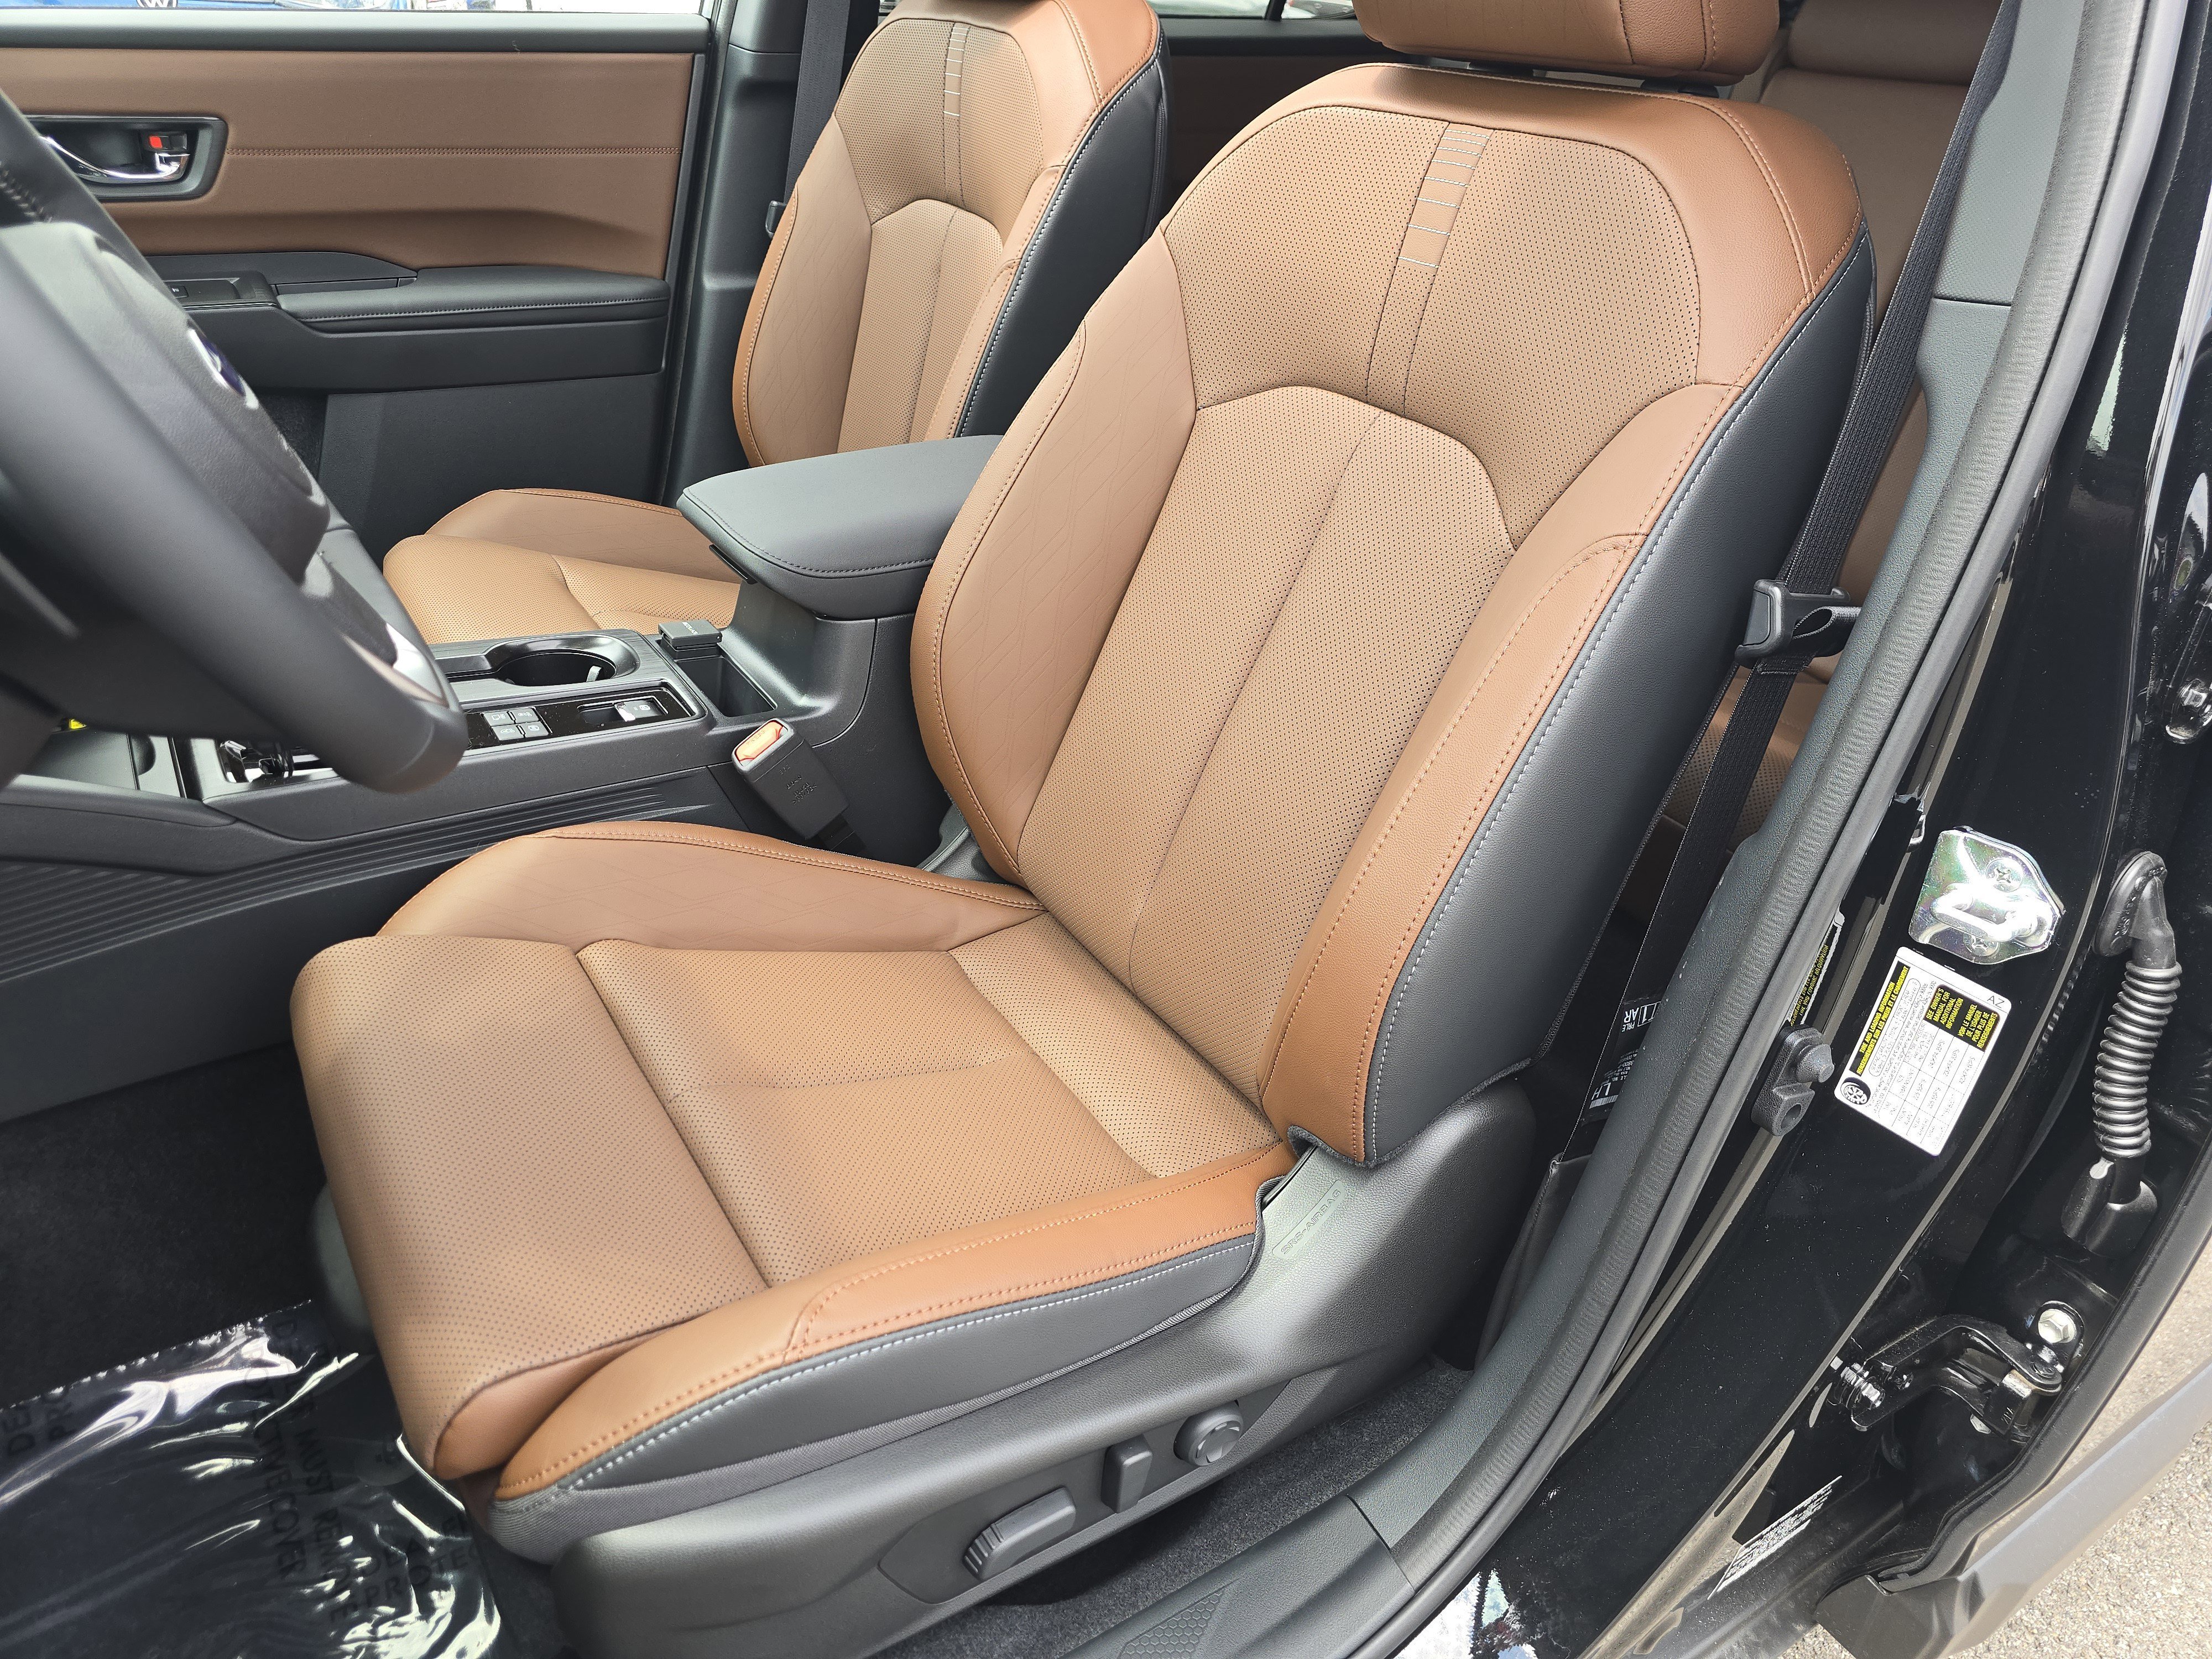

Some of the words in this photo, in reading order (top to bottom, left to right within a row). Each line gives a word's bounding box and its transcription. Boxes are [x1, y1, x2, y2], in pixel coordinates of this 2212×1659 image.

[1624, 1007, 1640, 1023] AR
[1926, 1010, 1934, 1020] SEE
[1931, 988, 1944, 1010] OWNER'S
[1933, 1003, 1945, 1021] MANUAL
[1942, 992, 1950, 1001] FOR
[1940, 998, 1956, 1025] ADDITIONAL
[1945, 998, 1963, 1029] INFORMATION
[1987, 994, 2005, 1009] AZ
[1857, 1039, 1876, 1074] RENSEIGNEMENTS
[1881, 1006, 1891, 1021] PNEUS
[1893, 966, 1909, 994] CHARGEMENT
[1859, 1042, 1869, 1053] TIRE
[1869, 1013, 1881, 1033] LOADING
[1879, 982, 1895, 1013] INFORMATION
[1958, 1026, 1966, 1036] VOIR
[1965, 1004, 1977, 1021] MANUEL
[1969, 1010, 1982, 1031] L'USAGER
[1971, 1030, 1981, 1042] POUR
[1977, 1019, 1986, 1030] PLUS
[1977, 1013, 1997, 1048] RENSEIGNEMENTS
[1591, 1082, 1611, 1100] LH
[1280, 1188, 1342, 1255] SRS-AIRBAG
[294, 1427, 334, 1495] MUST
[268, 1491, 306, 1580] COVER
